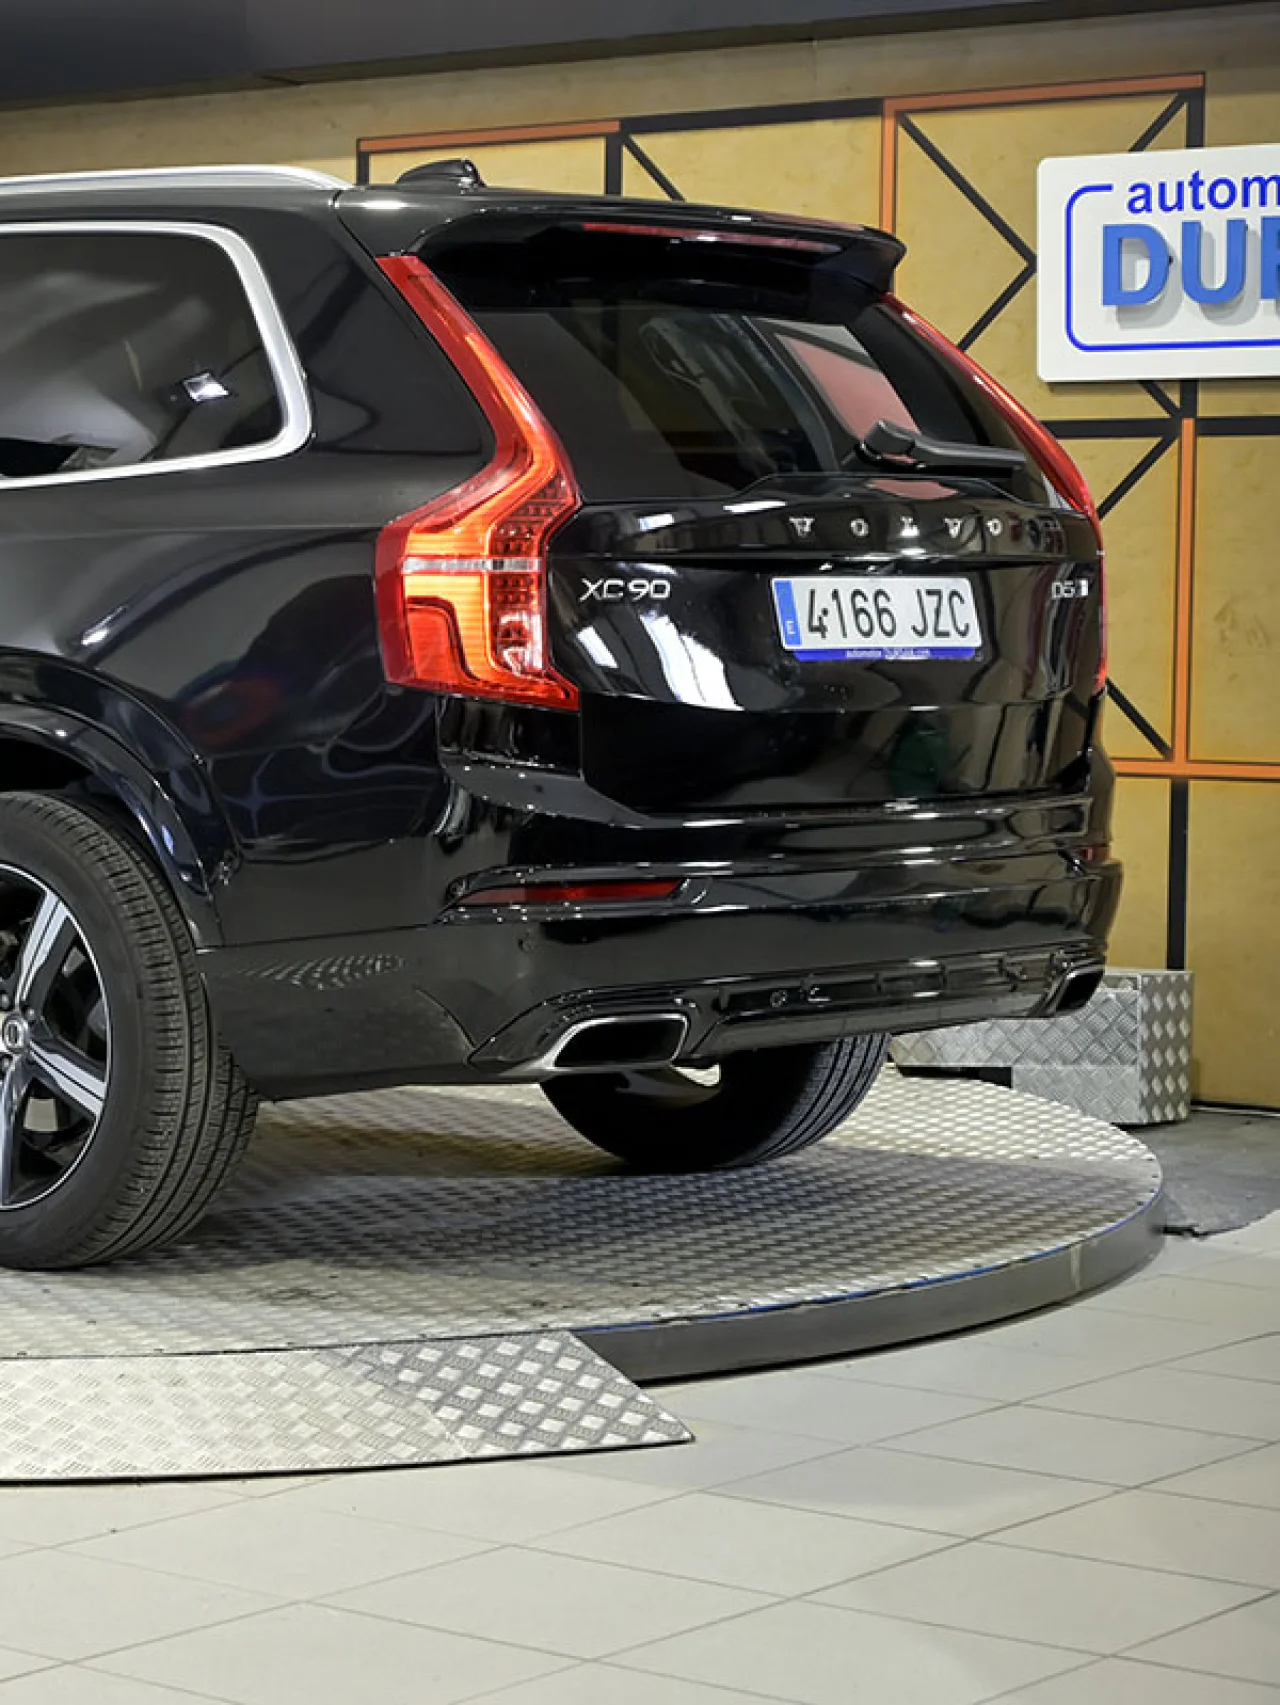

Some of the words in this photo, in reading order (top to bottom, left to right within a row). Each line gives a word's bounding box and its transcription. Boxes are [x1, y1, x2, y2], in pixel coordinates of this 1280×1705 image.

[789, 516, 1003, 538] VOLVO
[579, 578, 671, 602] XC90
[807, 588, 897, 638] 4166
[911, 588, 970, 637] JZC
